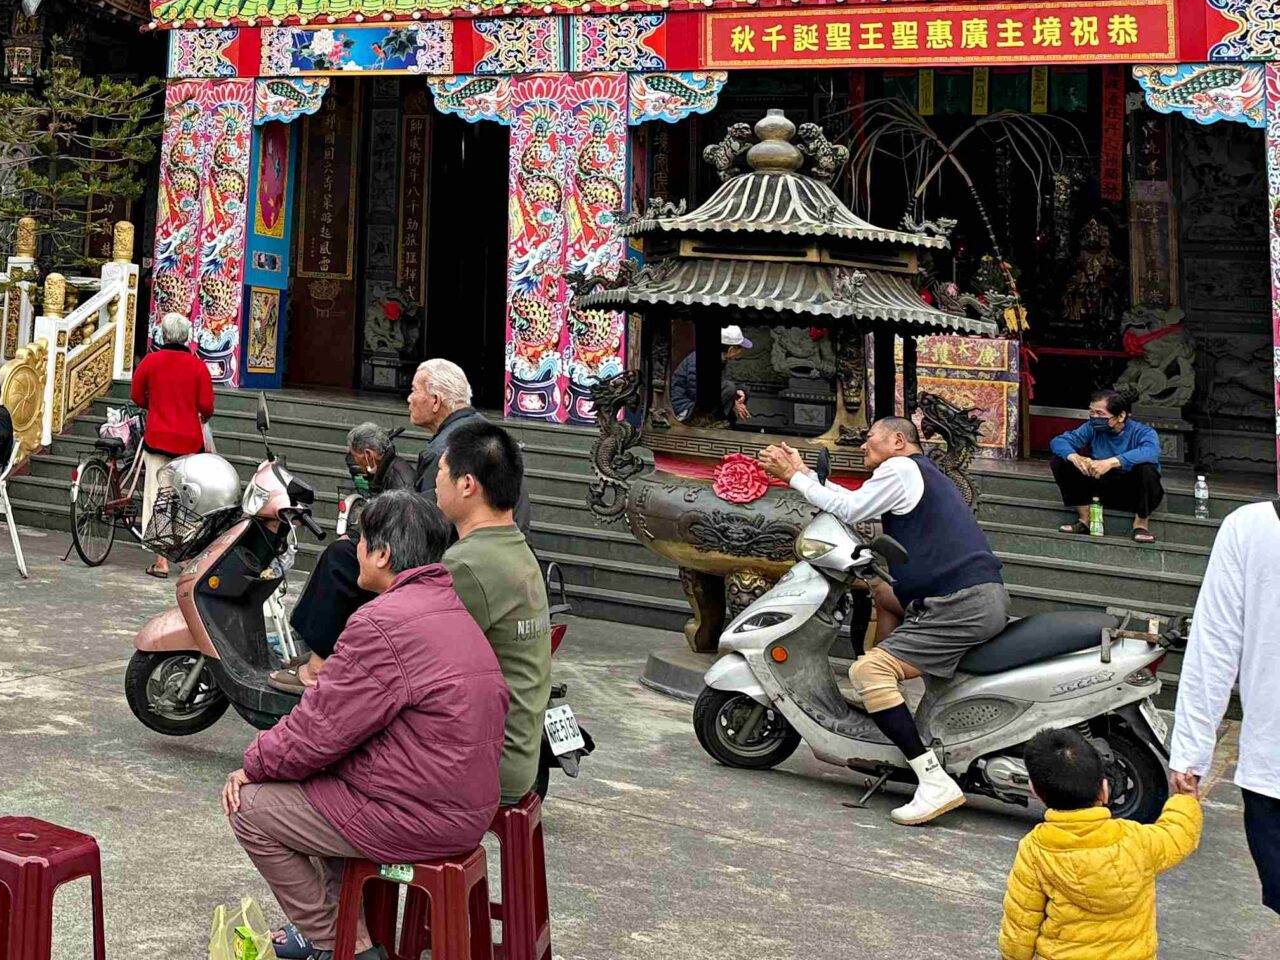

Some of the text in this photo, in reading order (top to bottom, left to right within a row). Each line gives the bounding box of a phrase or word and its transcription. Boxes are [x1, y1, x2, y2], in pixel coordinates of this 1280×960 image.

[730, 14, 1140, 56] 恭祝境主廣惠聖王聖誕千秋
